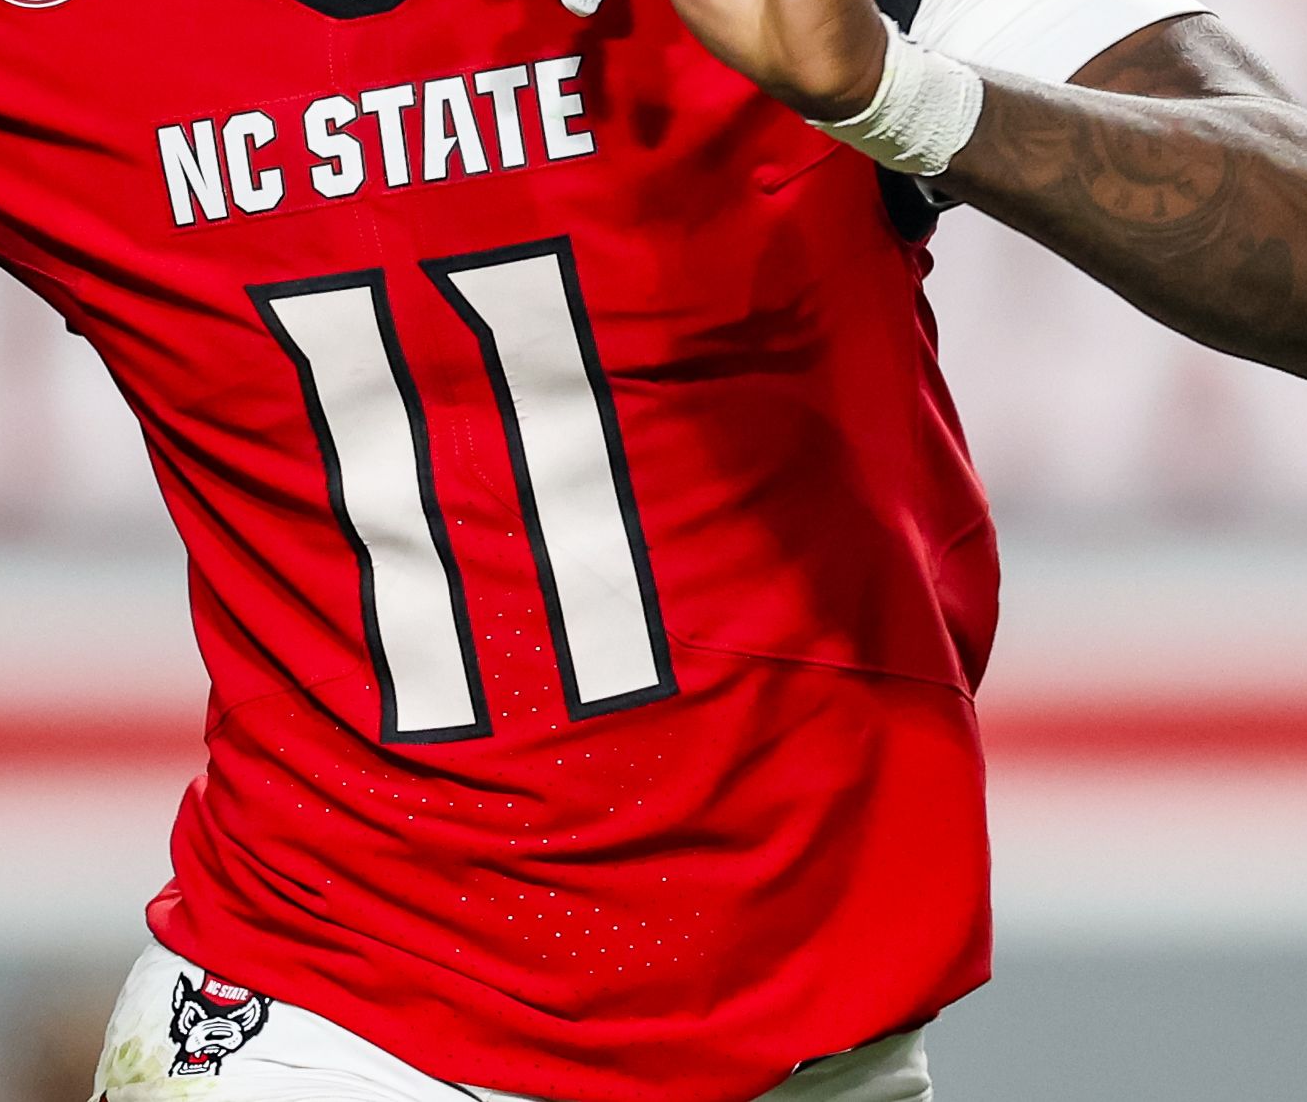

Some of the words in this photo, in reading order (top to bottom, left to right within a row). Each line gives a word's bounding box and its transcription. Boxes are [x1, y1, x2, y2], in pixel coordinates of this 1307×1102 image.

[155, 108, 286, 227] NC
[301, 54, 597, 200] STATE
[244, 234, 681, 745] 11
[205, 979, 222, 996] NC
[218, 984, 249, 1001] STATE
